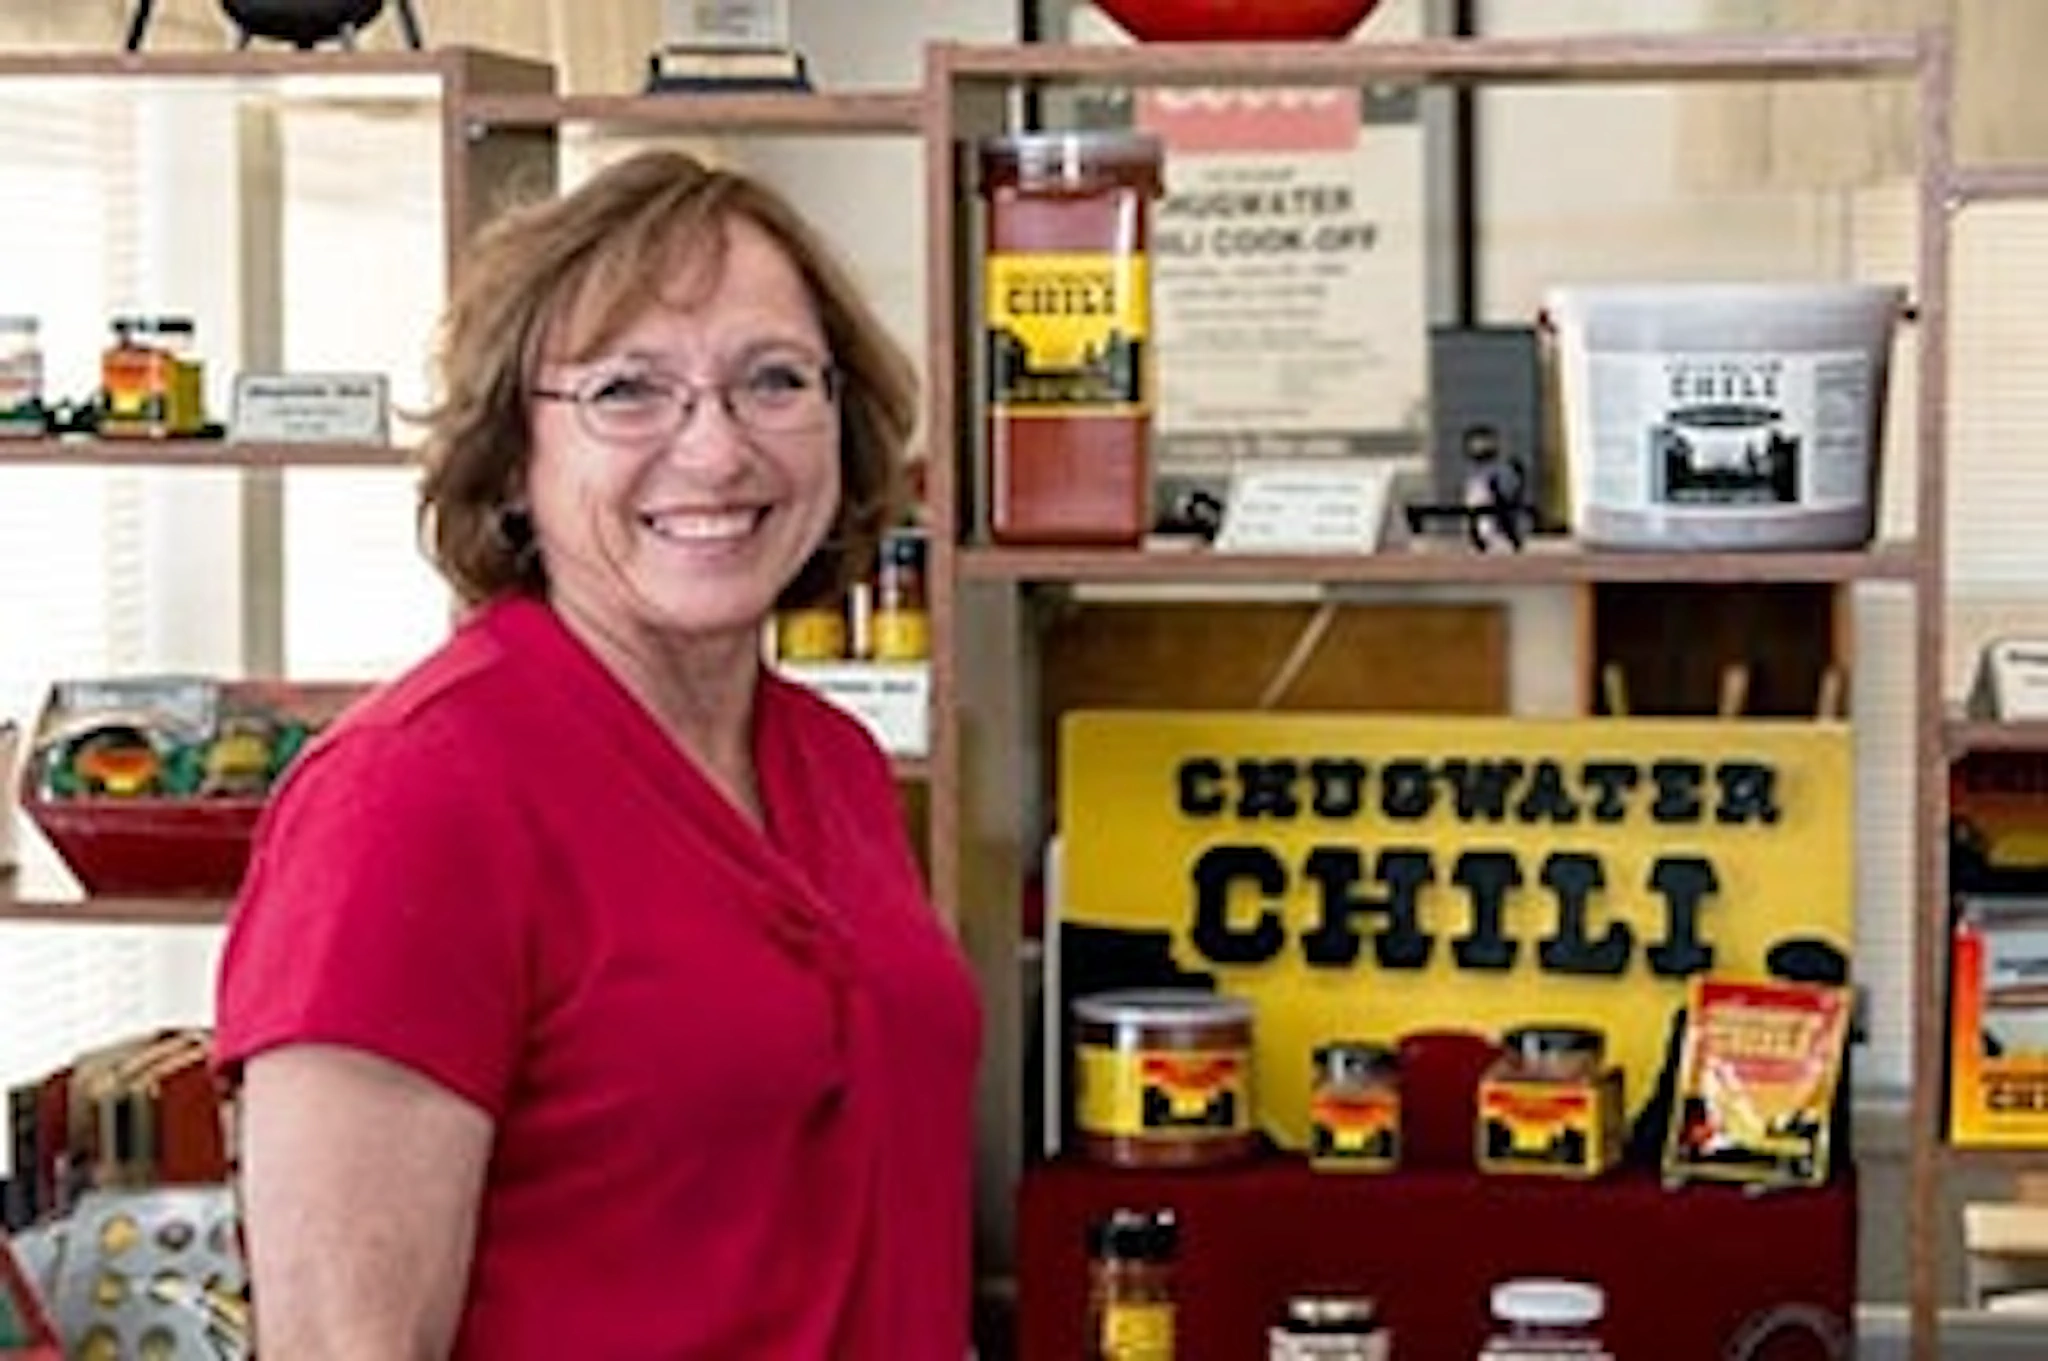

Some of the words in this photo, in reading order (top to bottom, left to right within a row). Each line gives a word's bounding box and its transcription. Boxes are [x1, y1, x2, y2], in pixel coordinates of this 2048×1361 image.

[1009, 287, 1115, 316] CHILI
[1671, 375, 1777, 397] CHILI
[1180, 758, 1782, 823] CHUGWATER
[1193, 846, 1719, 973] CHILI
